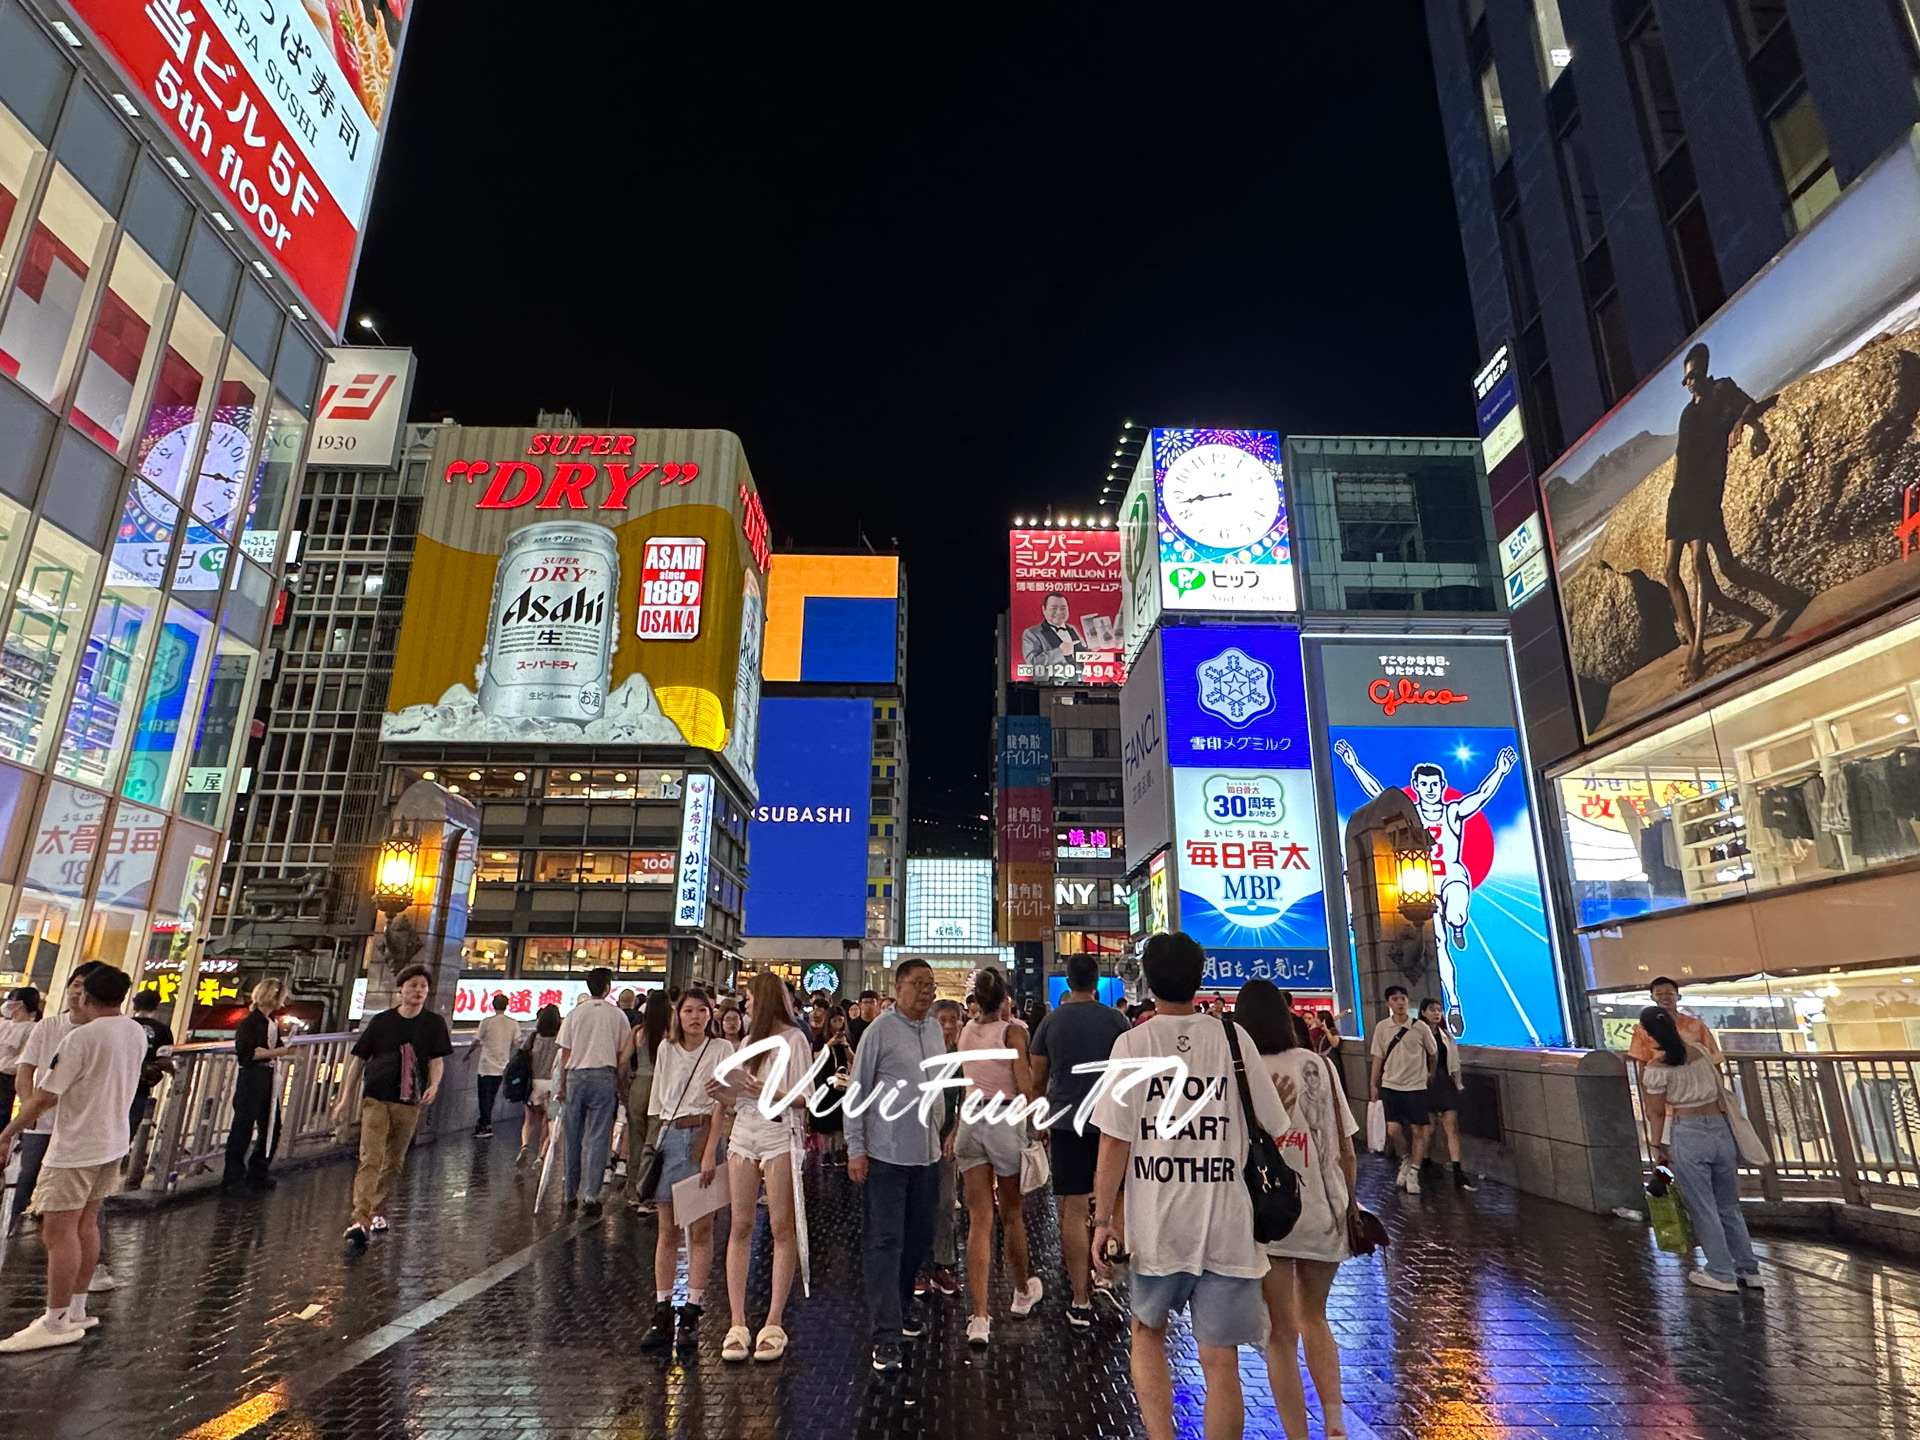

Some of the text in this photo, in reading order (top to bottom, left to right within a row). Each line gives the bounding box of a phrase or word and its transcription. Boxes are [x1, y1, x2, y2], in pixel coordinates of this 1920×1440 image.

[217, 0, 318, 147] PPA SUSHI
[156, 60, 291, 251] 5th floor
[316, 435, 357, 450] 1930
[527, 433, 636, 455] SUPER
[1015, 534, 1084, 550] スーパー
[543, 557, 580, 565] SUPER
[645, 546, 702, 570] ASAHI
[1015, 551, 1121, 567] ミリオンヘア
[659, 570, 686, 581] since
[1015, 568, 1057, 578] SUPER
[1060, 569, 1105, 578] MILLION
[643, 581, 700, 605] 1889
[502, 586, 605, 626] Asahi
[640, 610, 695, 633] OSAKA
[537, 630, 563, 646] 生
[517, 661, 578, 670] スーパードライ
[1369, 678, 1469, 716] Glico
[1125, 707, 1160, 782] FANCL
[1190, 737, 1292, 751] 雪印メグミルク
[1204, 829, 1291, 839] まいにちほねぶと
[1186, 840, 1311, 870] 毎日骨太
[1056, 883, 1095, 905] NY
[1222, 875, 1280, 900] MBP
[1134, 1156, 1235, 1183] MOTHER
